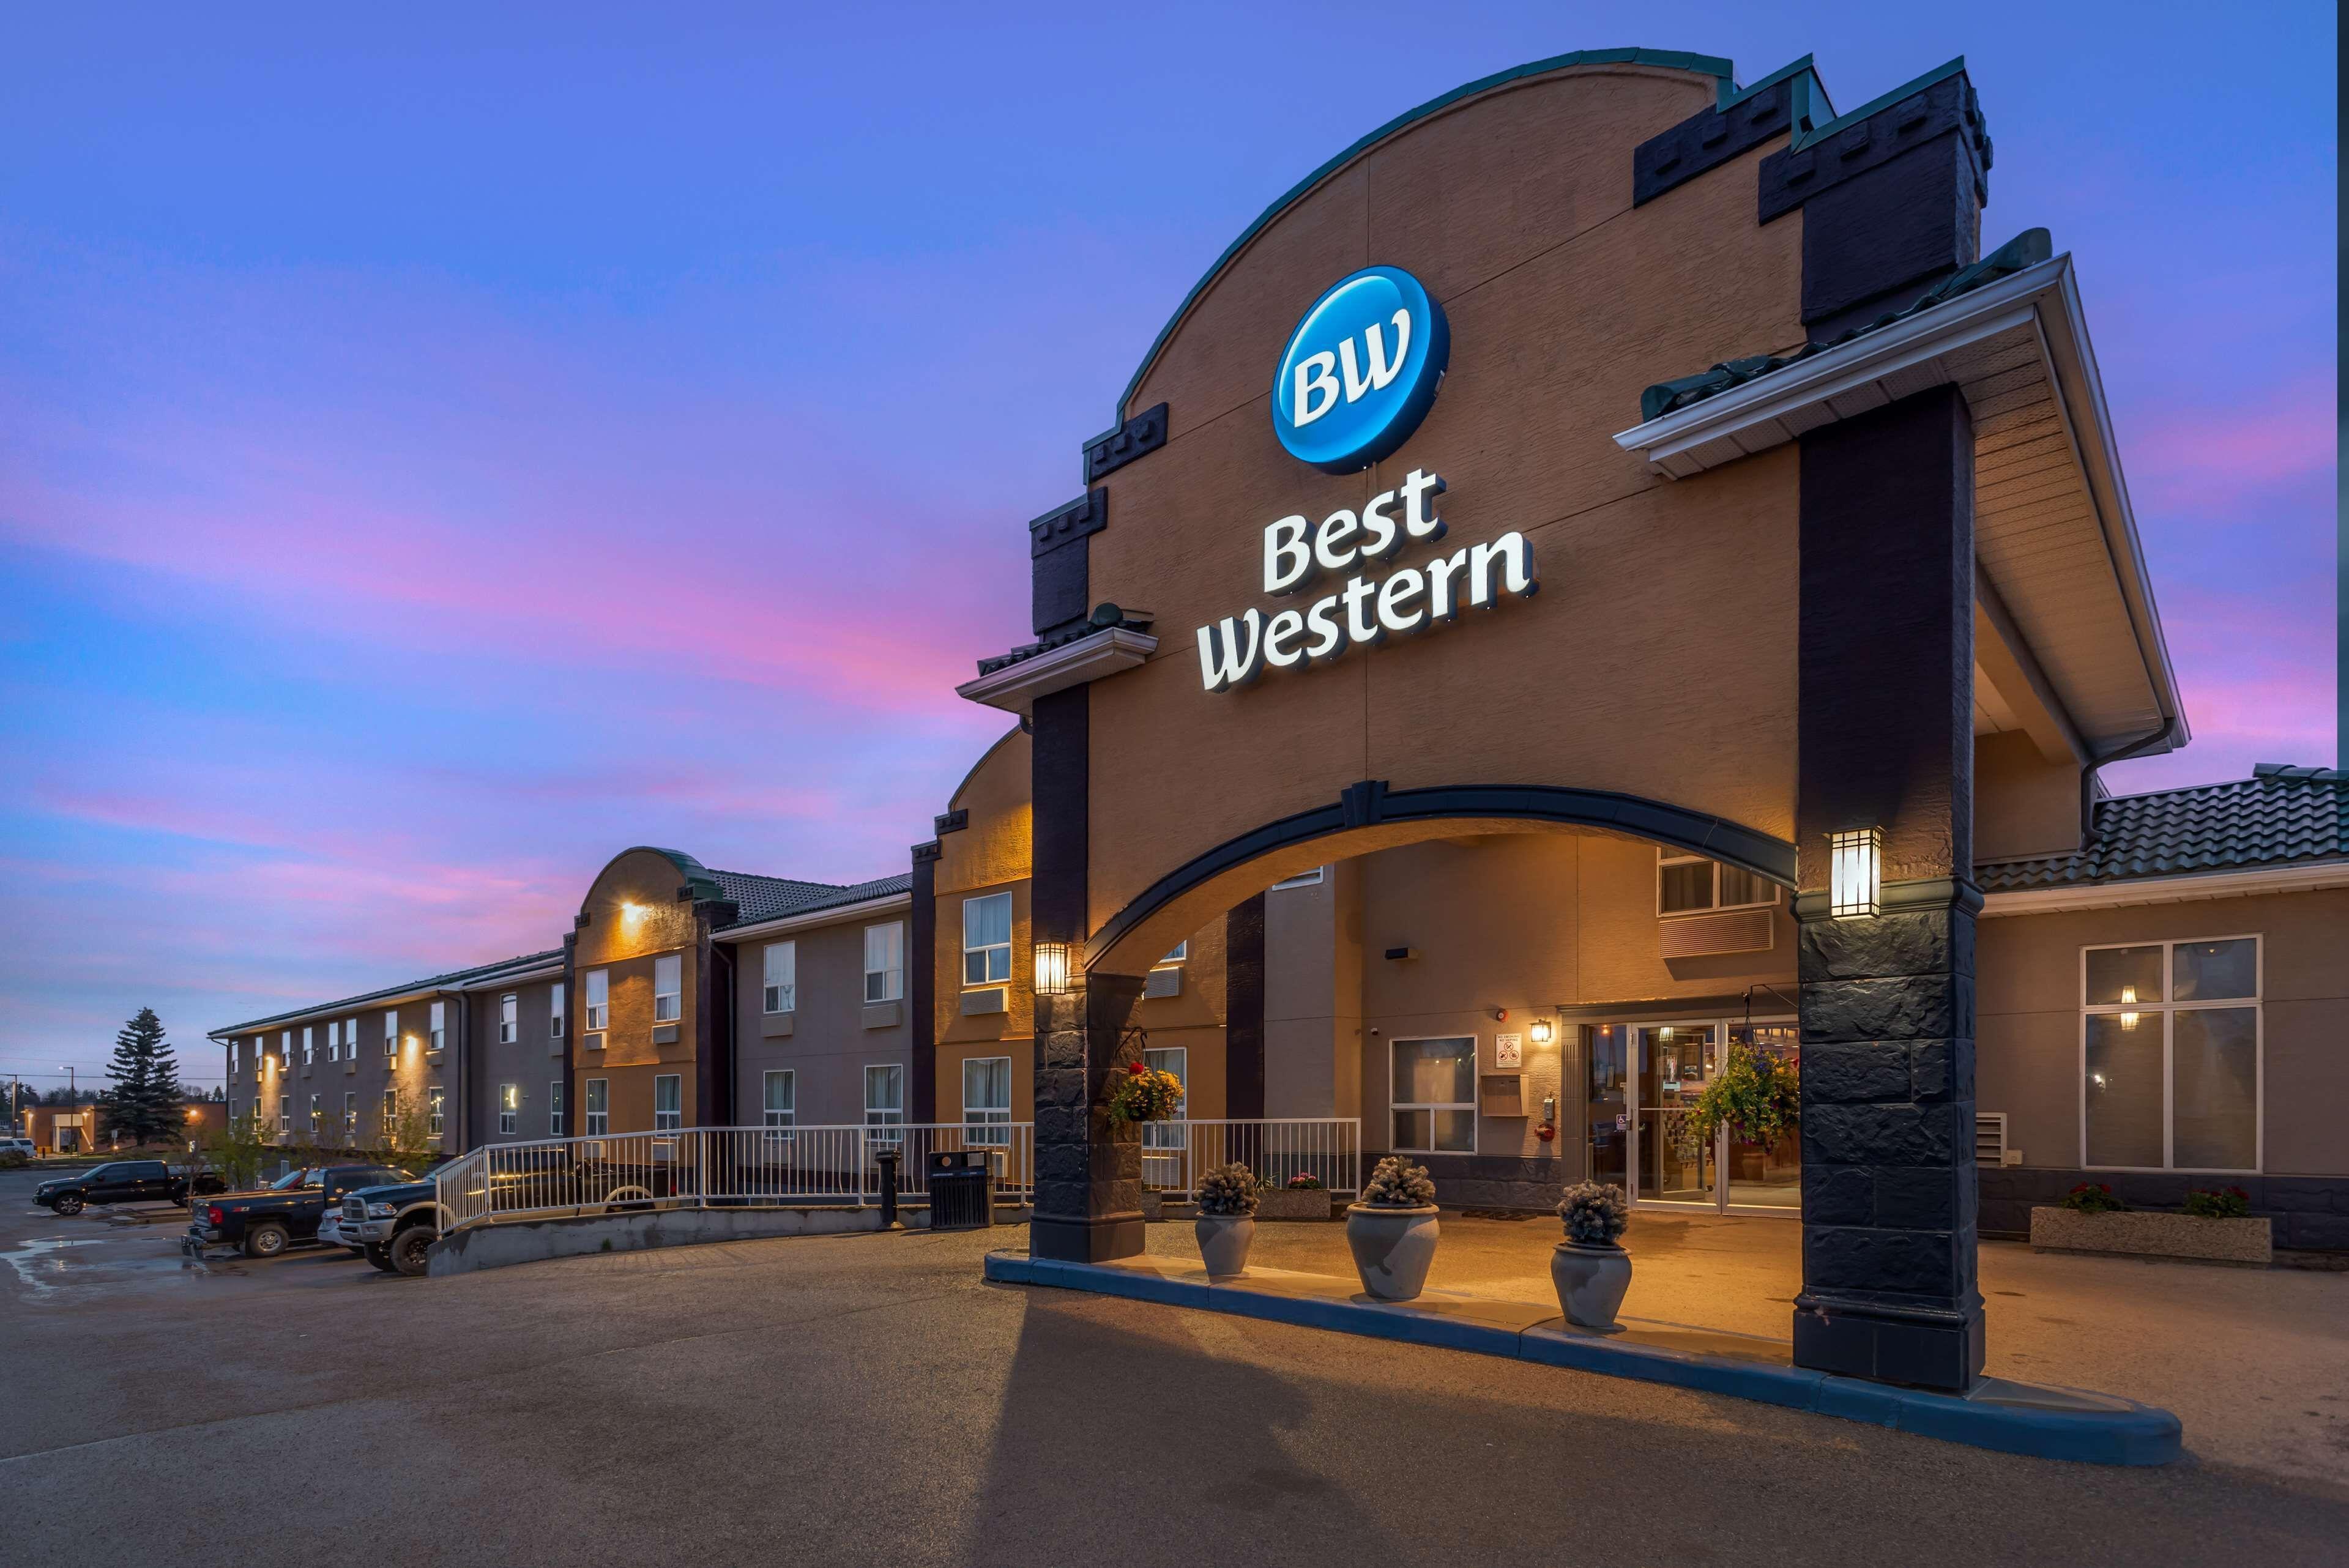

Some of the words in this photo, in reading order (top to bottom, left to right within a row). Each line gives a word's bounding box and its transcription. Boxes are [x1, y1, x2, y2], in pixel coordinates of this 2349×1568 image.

[1294, 308, 1410, 428] BW
[1264, 468, 1439, 593] Best
[1197, 532, 1530, 691] Western
